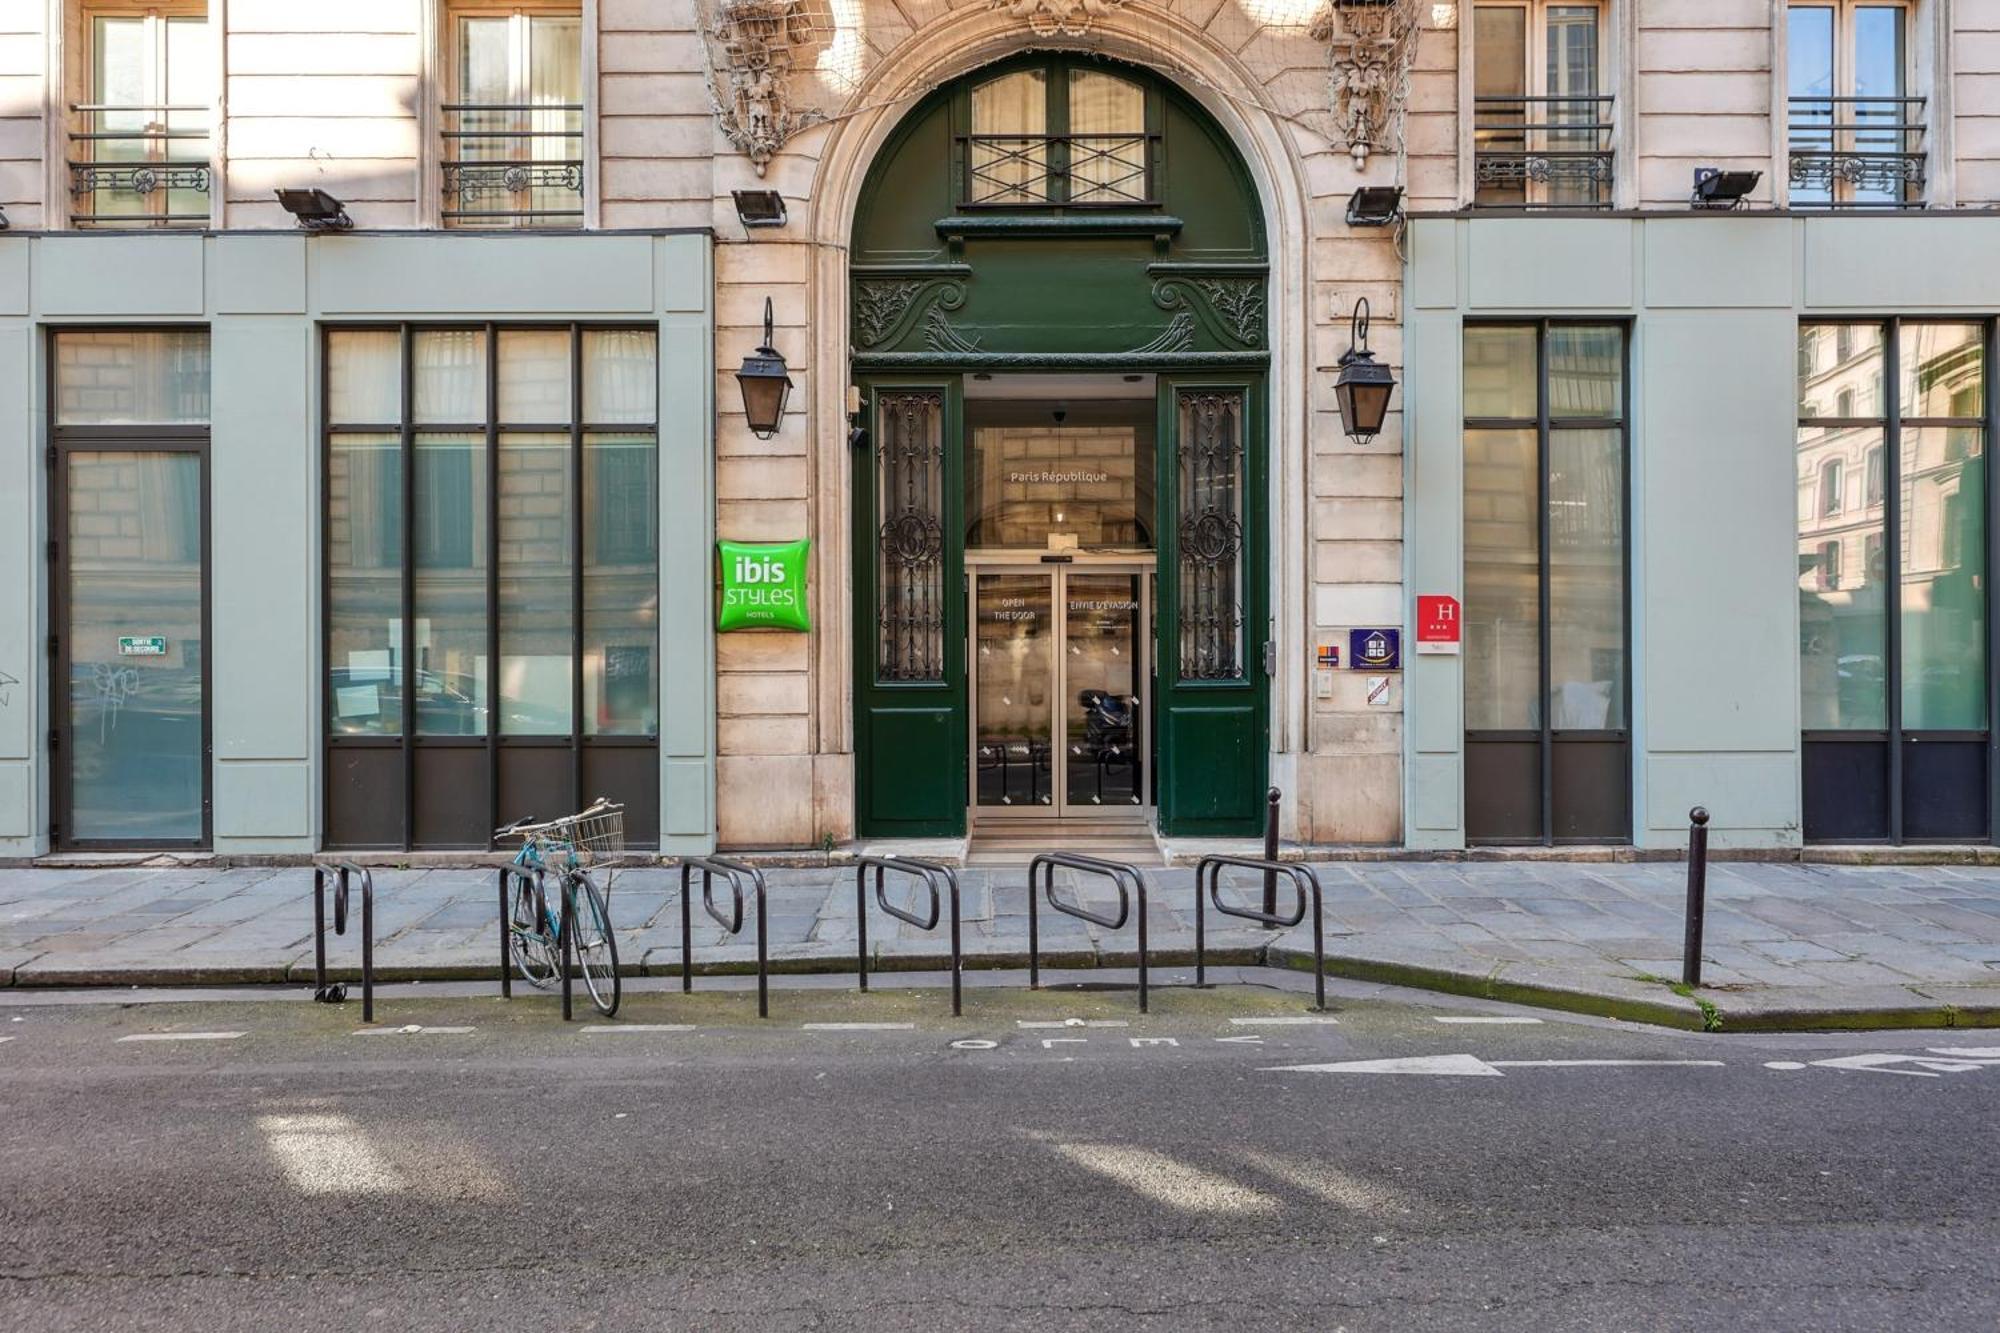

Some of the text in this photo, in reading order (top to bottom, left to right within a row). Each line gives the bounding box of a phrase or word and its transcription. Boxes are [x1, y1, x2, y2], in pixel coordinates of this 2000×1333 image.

[1010, 471, 1108, 484] Paris République
[735, 555, 785, 583] ibis
[1001, 598, 1025, 608] OPEN
[1069, 600, 1095, 610] ENVIE
[745, 610, 775, 619] HOTELS
[994, 611, 1036, 621] THE DOOR
[1437, 603, 1455, 621] H
